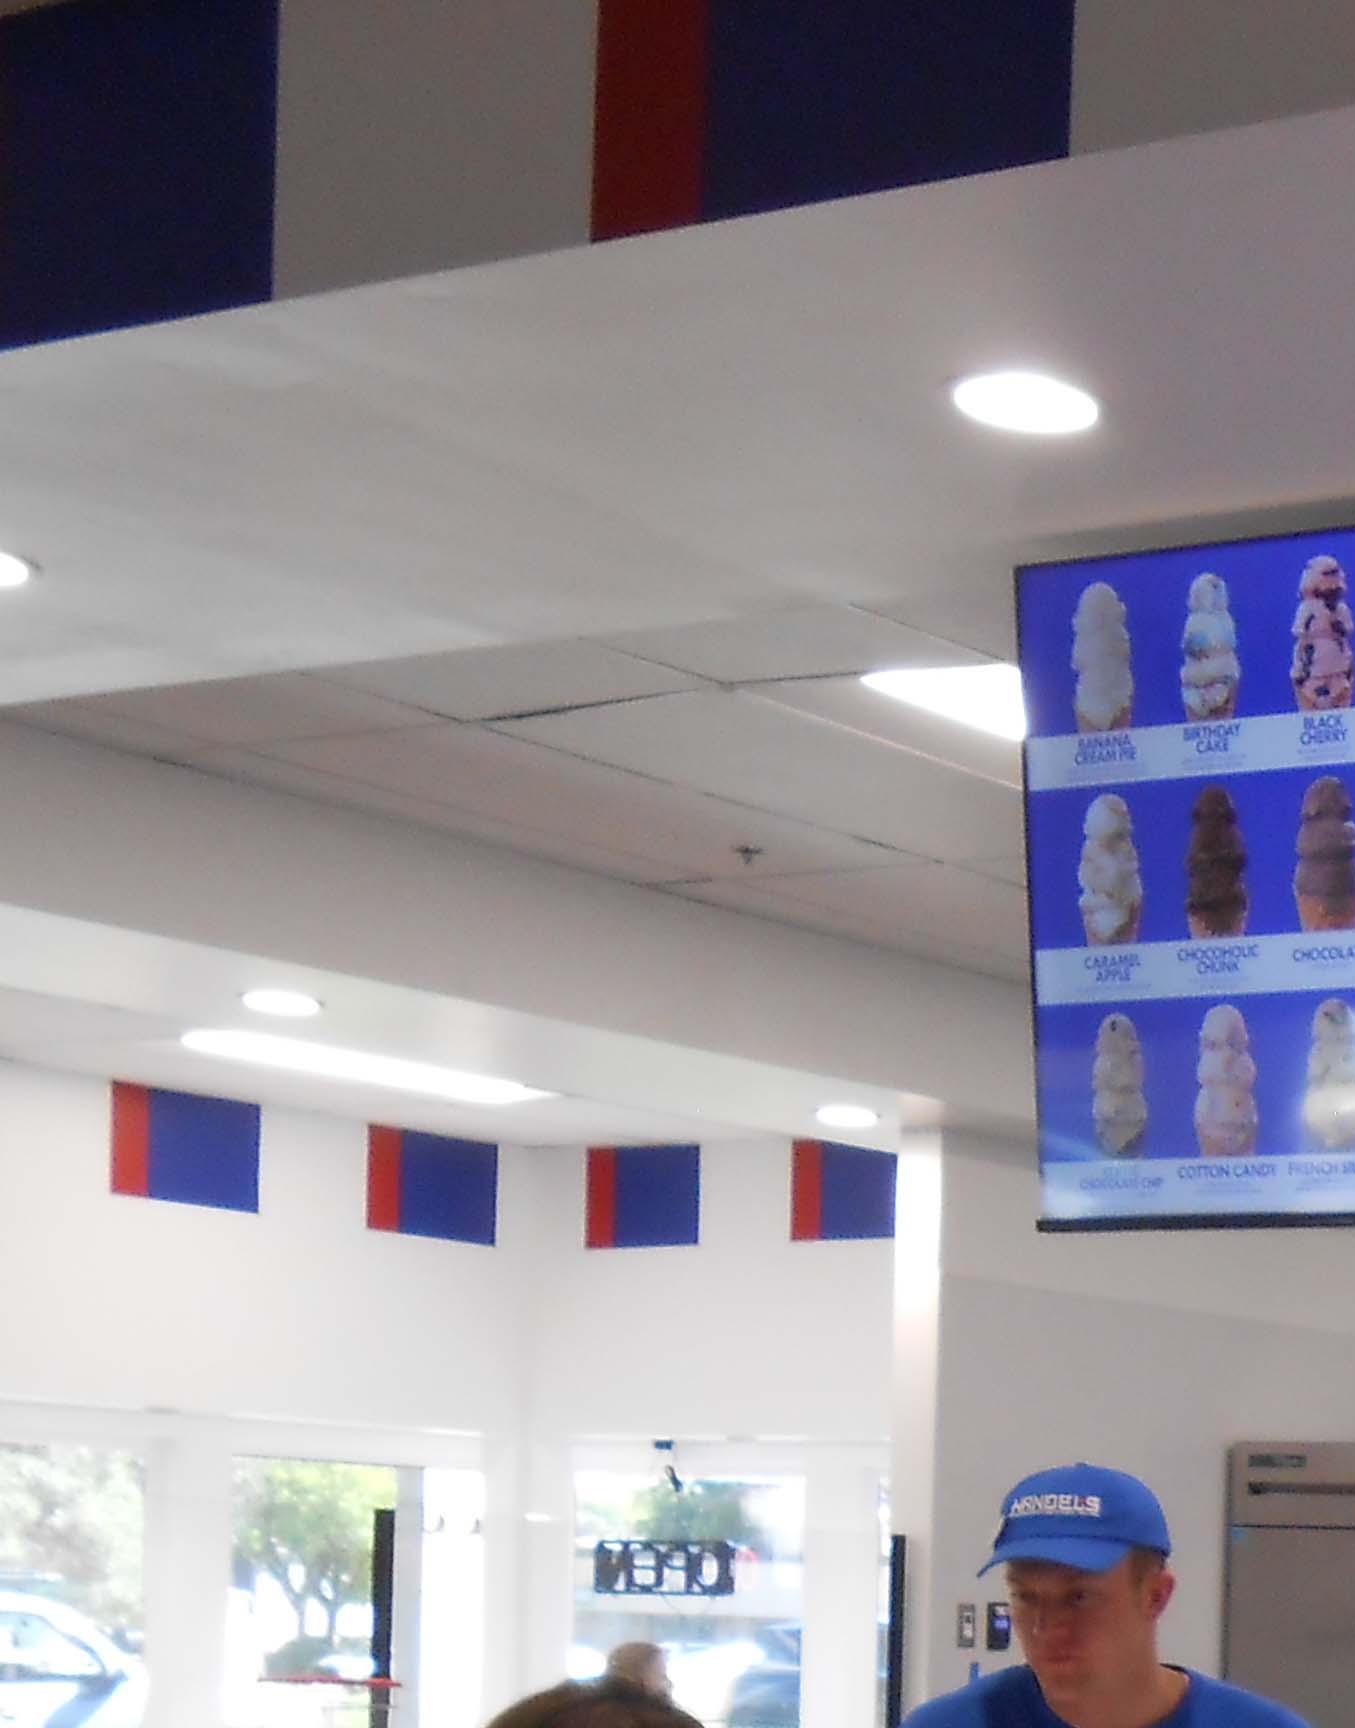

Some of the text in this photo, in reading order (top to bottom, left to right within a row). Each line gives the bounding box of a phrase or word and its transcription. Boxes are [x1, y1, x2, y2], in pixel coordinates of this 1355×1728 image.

[1303, 714, 1343, 730] BLACK
[1183, 723, 1240, 742] BIRTHDAY
[1300, 728, 1347, 745] CHERRY
[1079, 733, 1132, 751] BANANA
[1196, 739, 1229, 753] CAKE
[1177, 944, 1260, 962] CHOCOHOLIC
[1178, 1163, 1277, 1180] COTTON CANDY
